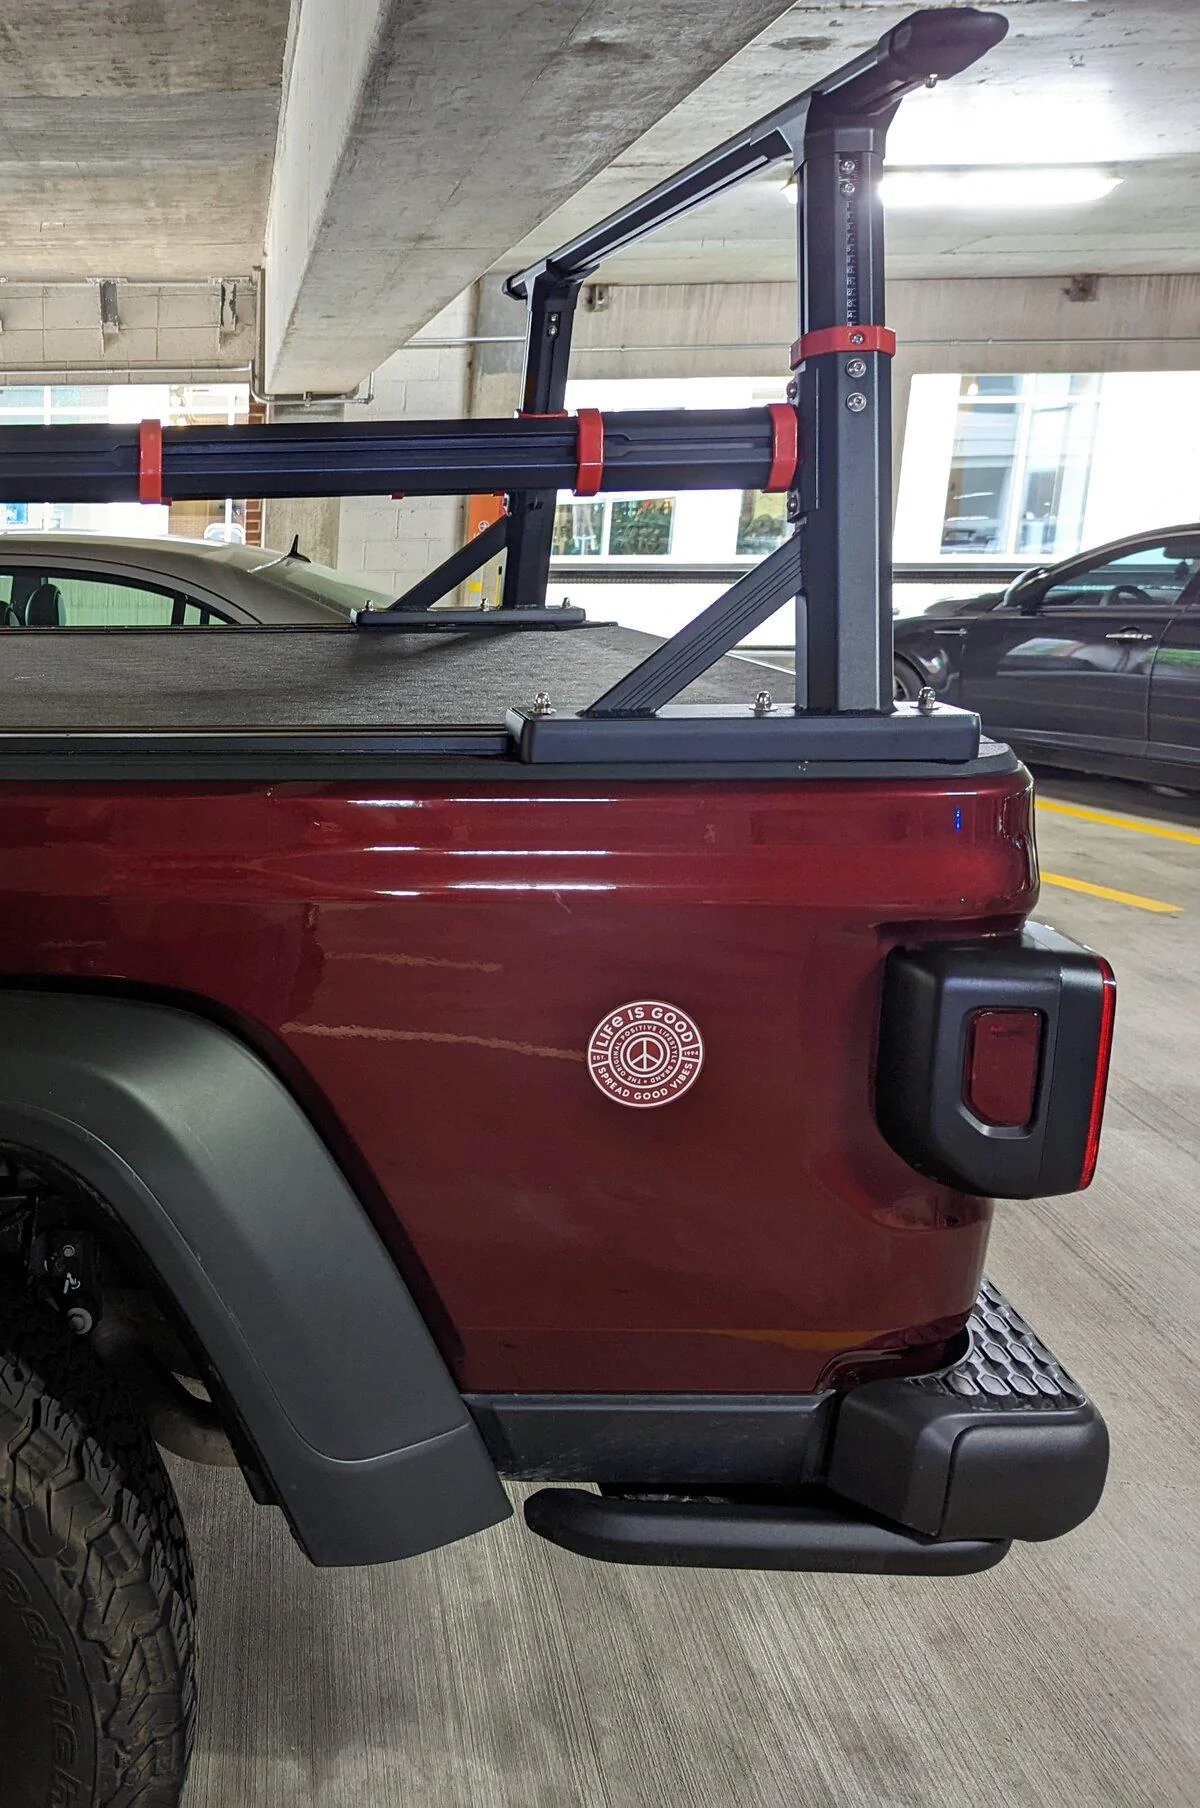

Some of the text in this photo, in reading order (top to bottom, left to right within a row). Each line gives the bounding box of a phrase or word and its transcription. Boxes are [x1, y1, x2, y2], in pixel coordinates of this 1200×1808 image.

[628, 1007, 645, 1021] IS
[651, 1007, 694, 1043] GOOD
[613, 1025, 678, 1084] THE ORIGINAL POSITIVE LIFESTYLE BRAND
[598, 1063, 693, 1100] SPREAD GOOD VIBES
